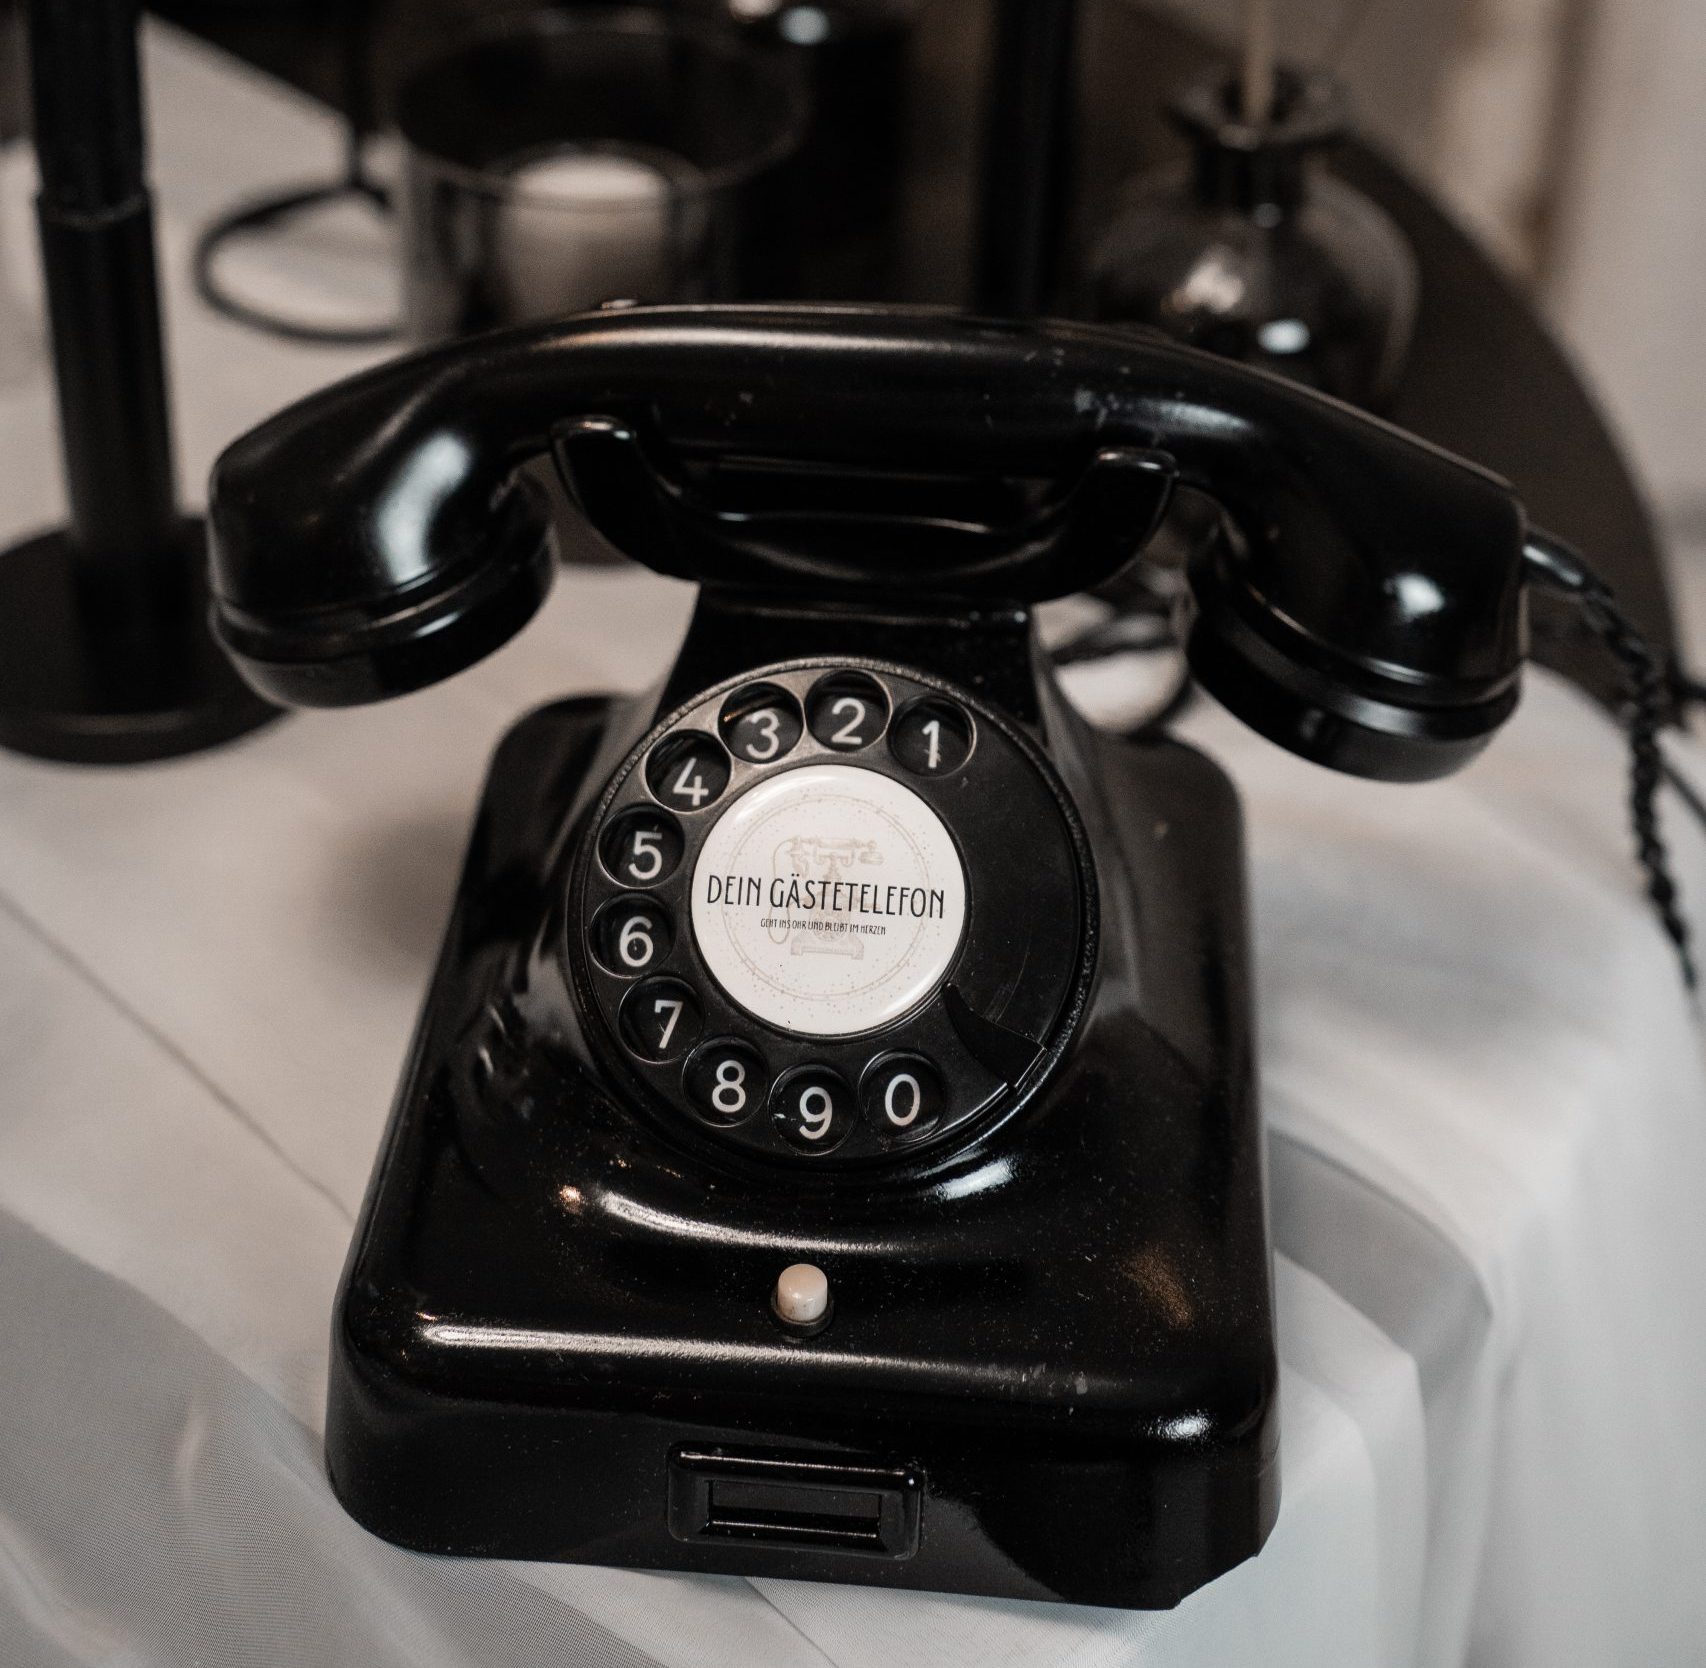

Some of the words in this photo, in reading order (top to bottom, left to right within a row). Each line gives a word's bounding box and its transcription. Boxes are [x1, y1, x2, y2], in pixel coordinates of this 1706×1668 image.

[746, 709, 780, 760] 3
[832, 698, 863, 745] 2
[922, 720, 940, 769] 1
[672, 757, 709, 806] 4
[628, 830, 663, 880] 5
[706, 874, 762, 906] DEIN
[769, 873, 945, 919] GÄSTETELEFON
[618, 915, 654, 967] 6
[760, 918, 777, 928] GEHT
[779, 919, 791, 929] INS
[792, 920, 807, 930] OHR
[807, 921, 824, 931] UND
[824, 922, 848, 932] BLEIBT
[849, 923, 859, 933] IM
[860, 924, 886, 936] HERZEN
[653, 999, 683, 1049] 7
[711, 1059, 747, 1113] 8
[884, 1073, 920, 1126] 0
[799, 1086, 833, 1140] 9
